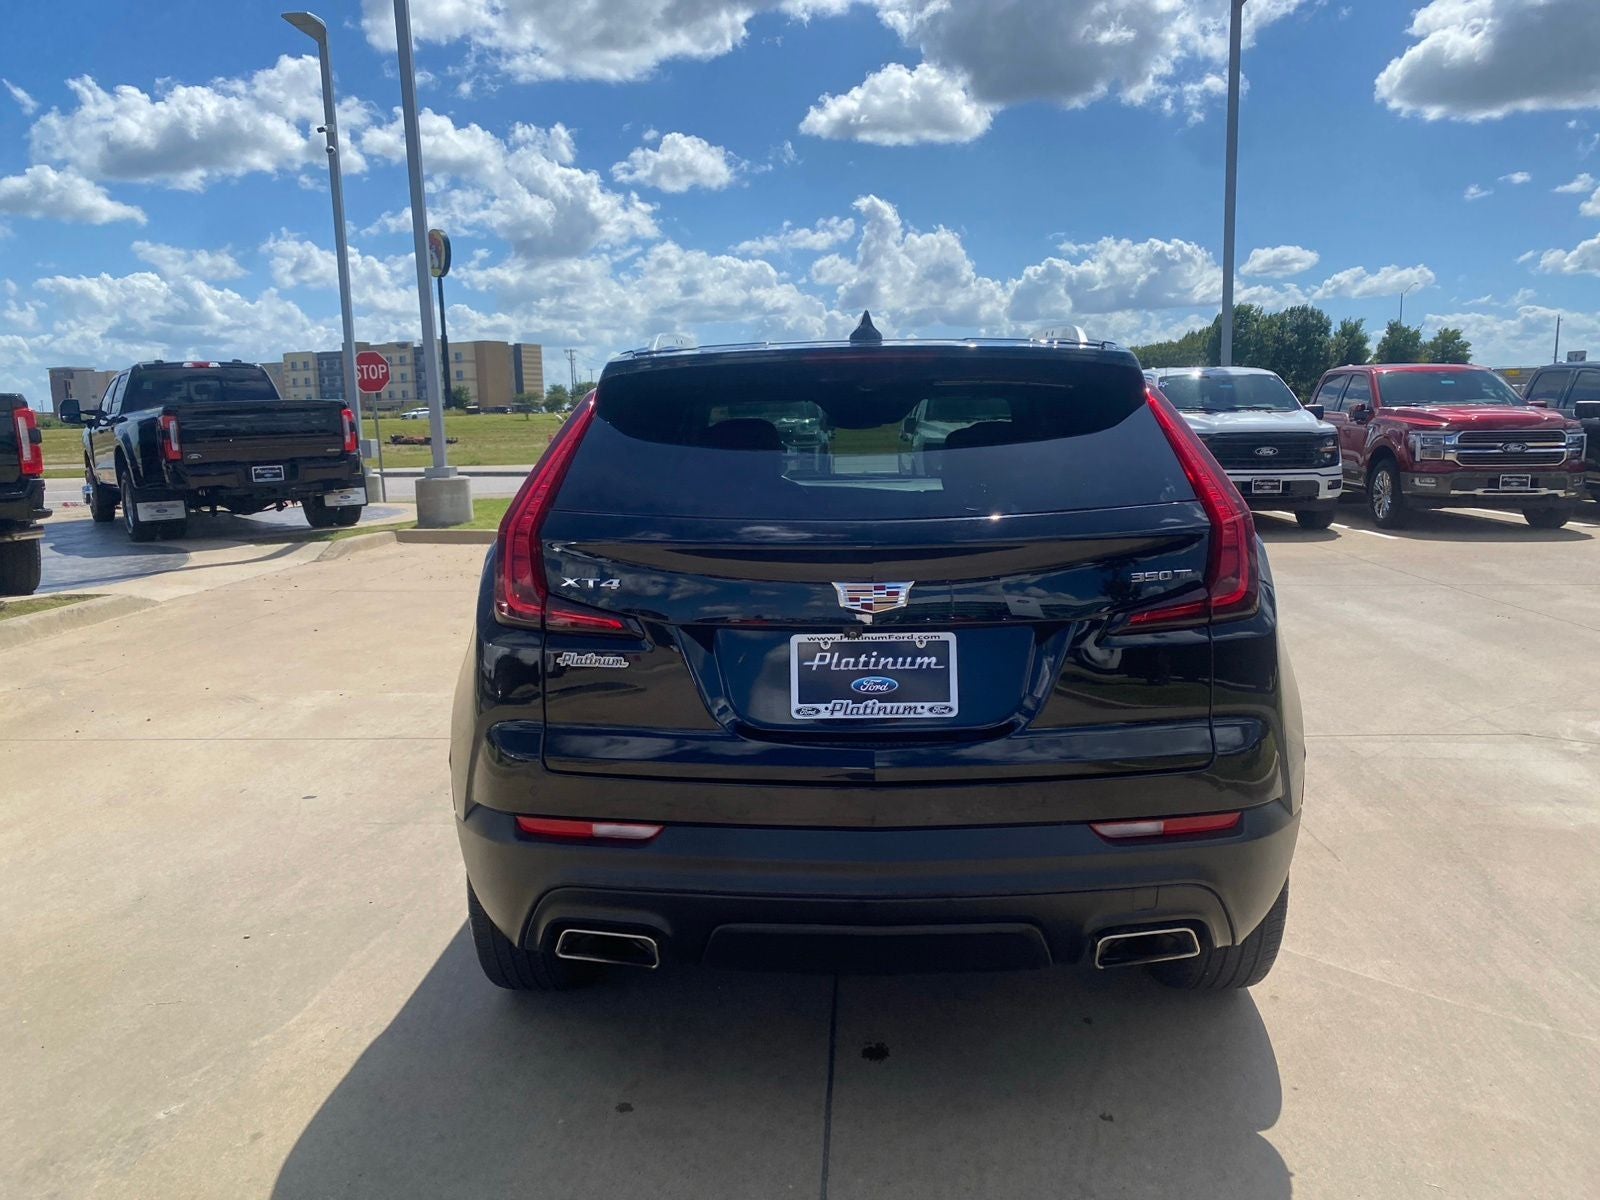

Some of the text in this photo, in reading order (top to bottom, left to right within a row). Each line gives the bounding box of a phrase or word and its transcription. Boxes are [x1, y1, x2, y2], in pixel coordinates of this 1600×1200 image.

[356, 364, 388, 380] STOP
[561, 577, 621, 590] XT4
[1131, 569, 1193, 583] 350T
[556, 652, 629, 668] Platinum
[803, 651, 945, 671] Platinum
[859, 679, 889, 693] Ford
[829, 701, 925, 716] Platinum
